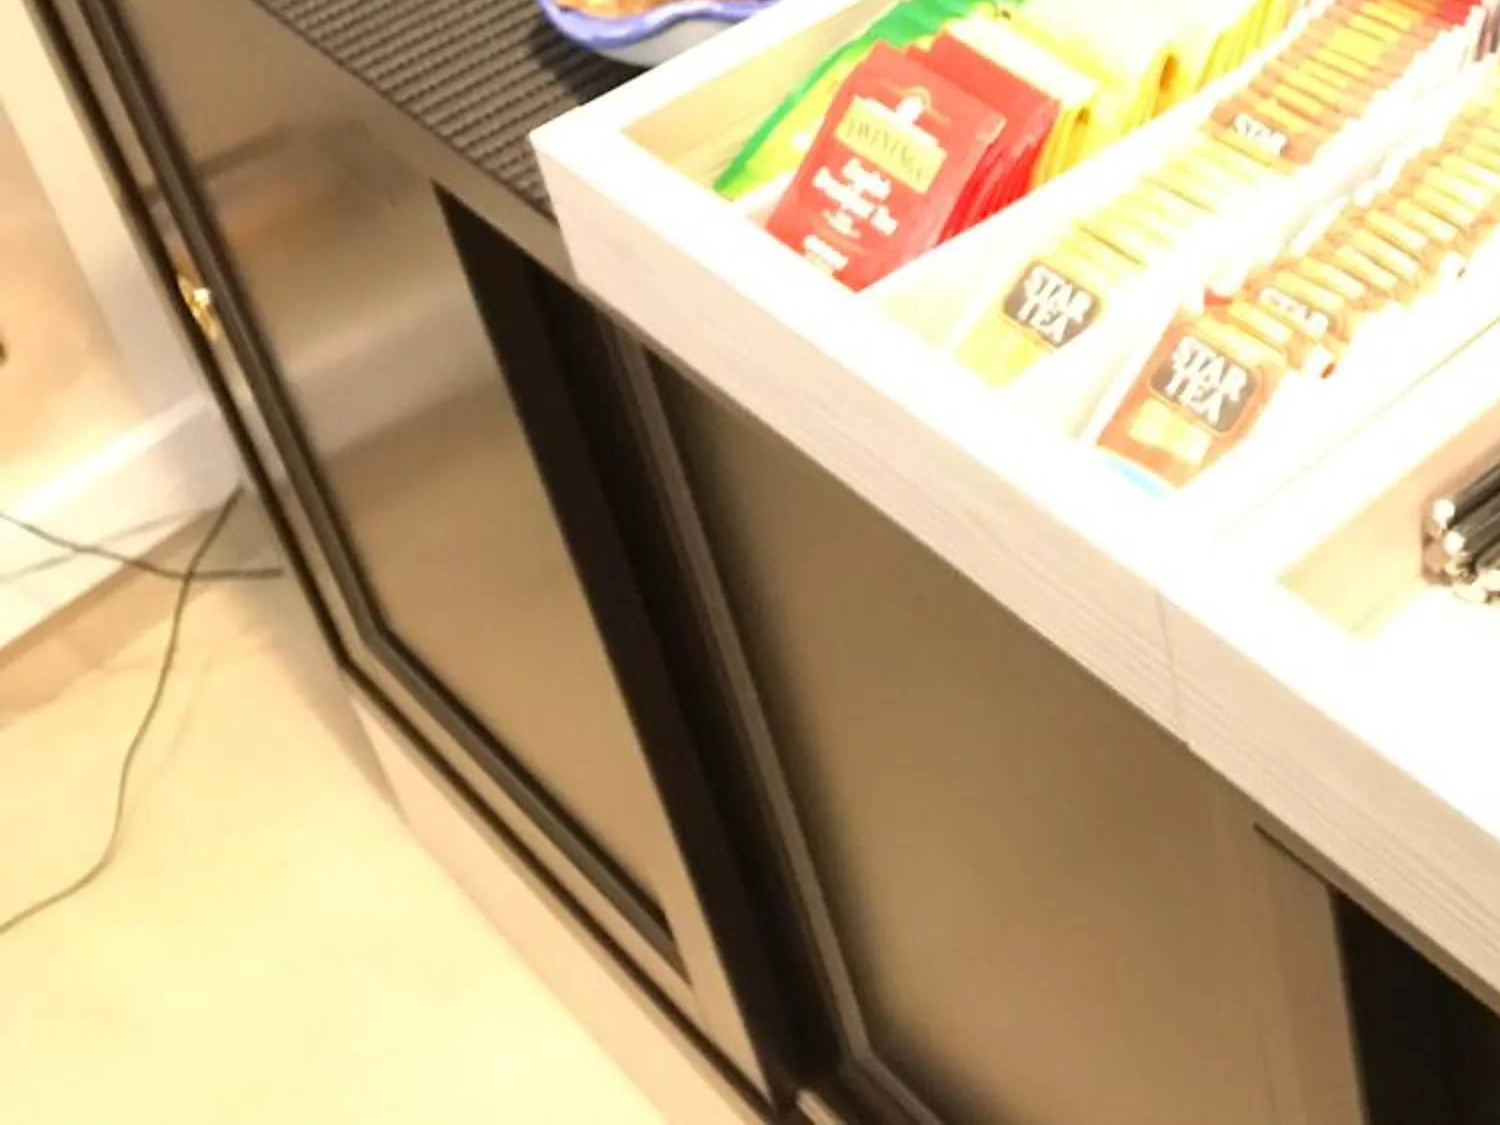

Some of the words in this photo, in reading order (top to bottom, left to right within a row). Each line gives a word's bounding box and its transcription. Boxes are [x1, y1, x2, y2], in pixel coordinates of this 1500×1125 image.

[1016, 291, 1073, 345] TEA
[1022, 263, 1094, 324] STAR
[1170, 333, 1250, 402] STAR
[1163, 370, 1224, 425] TEA
